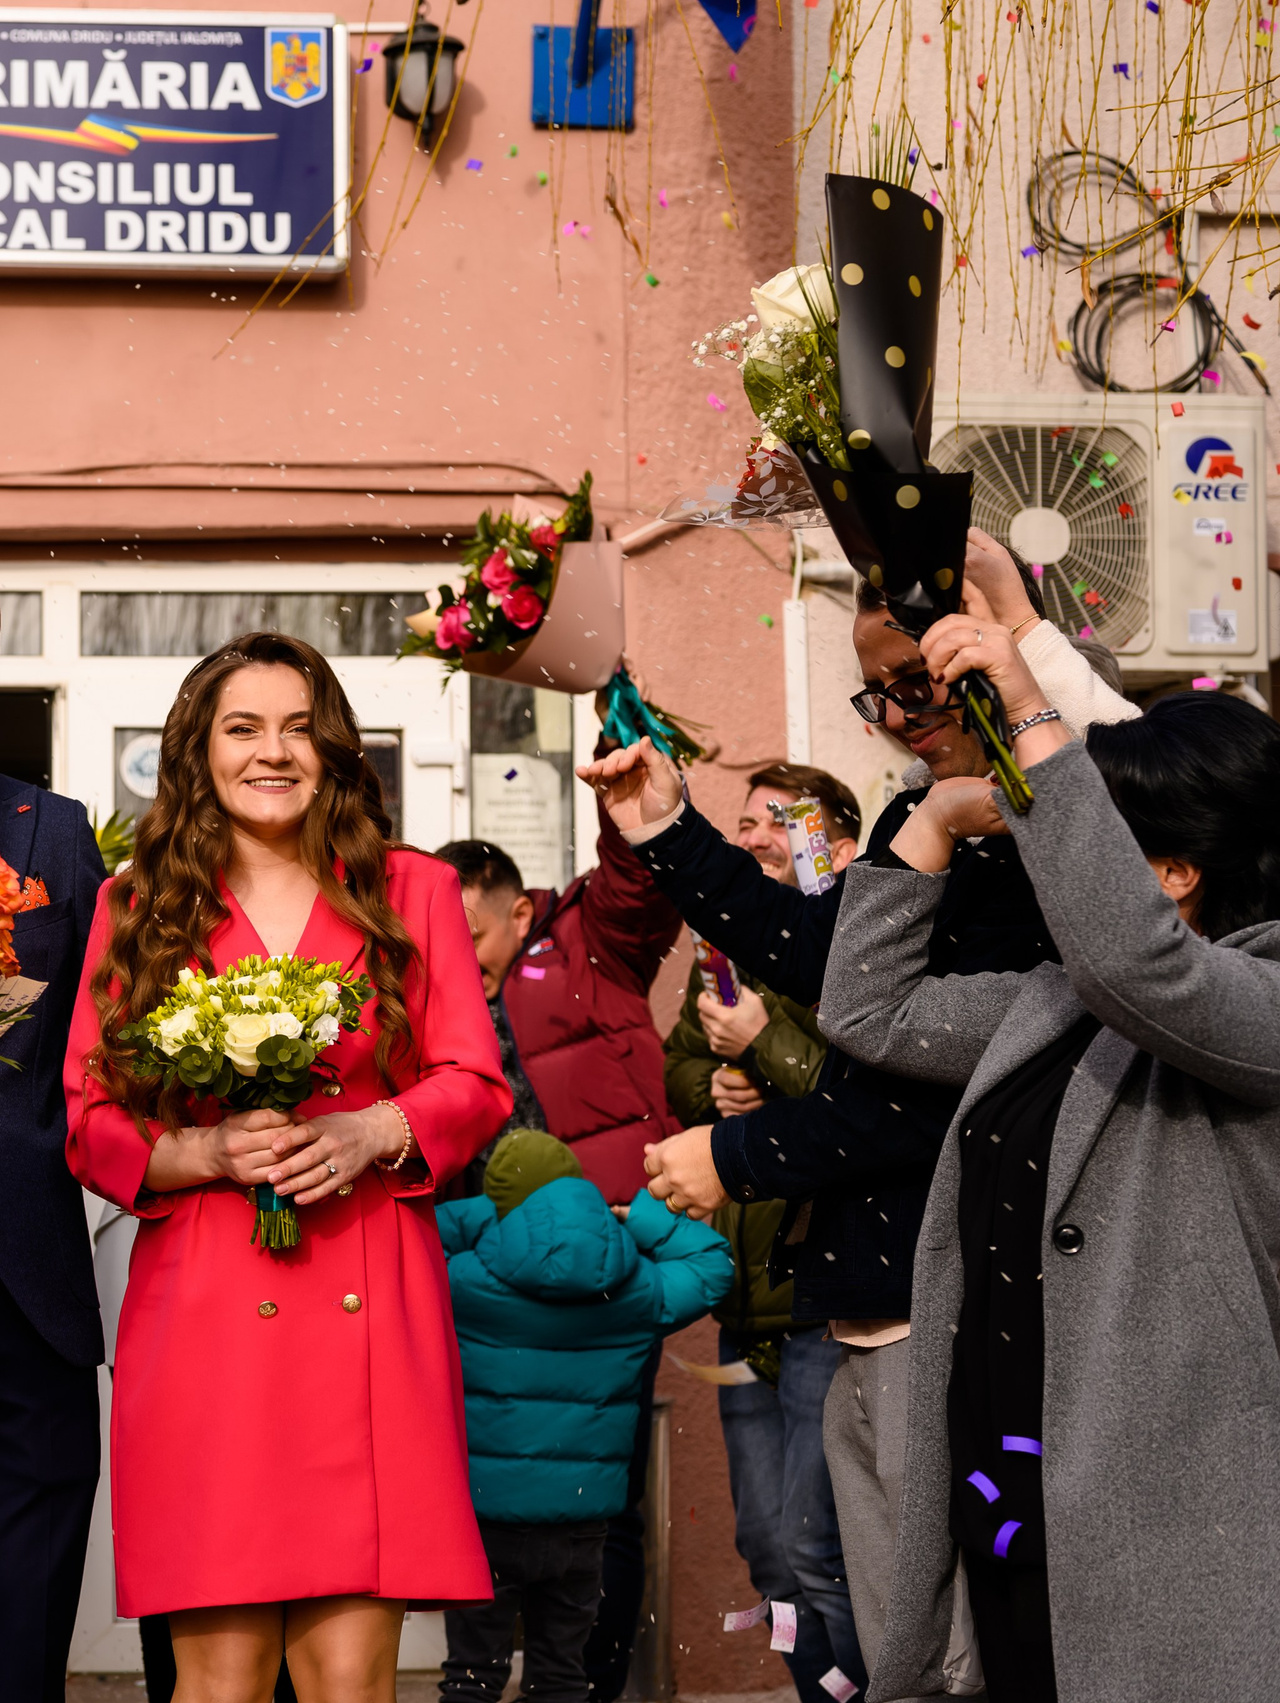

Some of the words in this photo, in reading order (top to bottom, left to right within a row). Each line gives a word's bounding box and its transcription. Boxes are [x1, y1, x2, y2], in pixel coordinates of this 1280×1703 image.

[9, 29, 70, 43] COMUNA
[71, 30, 114, 44] DRIDU
[104, 209, 292, 254] DRIDU
[1172, 483, 1249, 502] GREE
